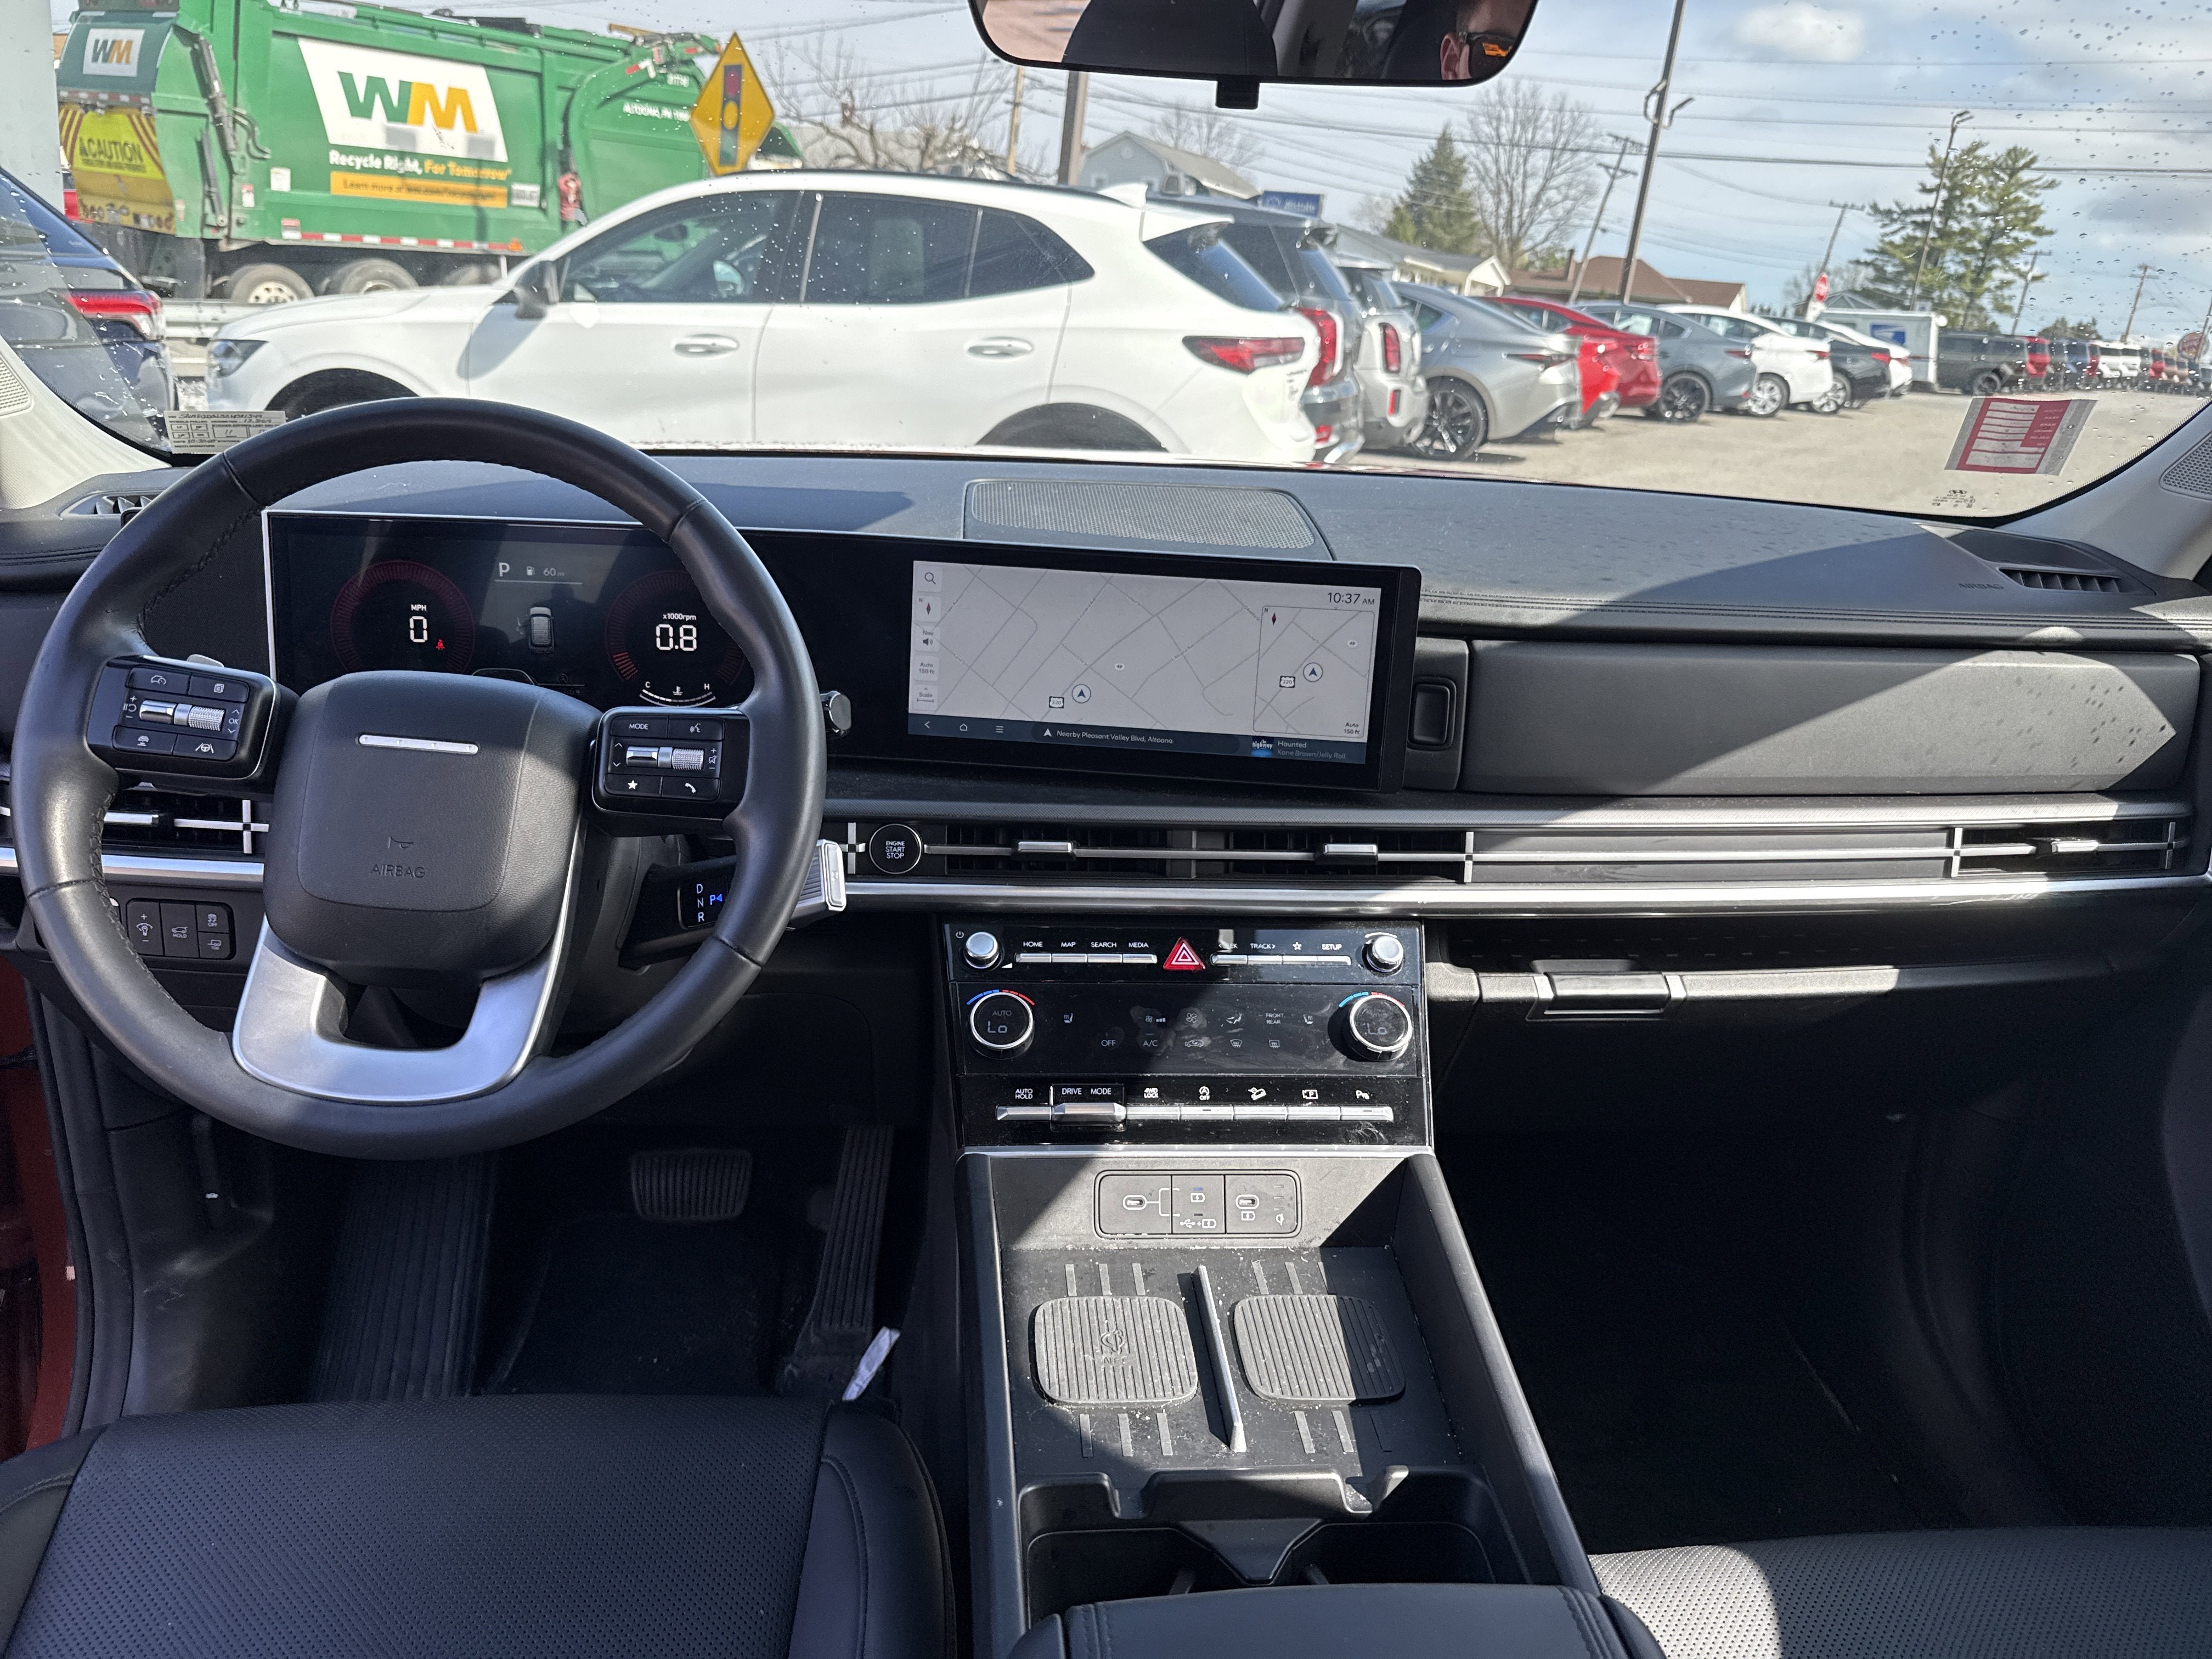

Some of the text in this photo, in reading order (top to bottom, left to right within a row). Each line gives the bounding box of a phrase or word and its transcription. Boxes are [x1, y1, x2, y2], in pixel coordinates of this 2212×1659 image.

[92, 39, 133, 64] WM
[337, 71, 478, 133] WM
[87, 138, 143, 163] CAUTION
[329, 149, 382, 170] Recycle
[424, 159, 446, 175] For
[499, 562, 510, 577] P
[543, 568, 556, 577] 60
[1328, 592, 1361, 604] 10:37
[663, 613, 697, 622] x1000rpm
[409, 616, 428, 643] 0
[656, 624, 697, 651] 0.8
[1057, 730, 1080, 738] Nearby
[1082, 731, 1110, 740] Pleasant
[1110, 733, 1130, 742] Valley
[1131, 735, 1147, 743] Blvd,
[371, 864, 425, 878] AIRBAG
[696, 883, 703, 895] D
[697, 898, 704, 909] N
[709, 894, 716, 905] P
[697, 912, 705, 923] R
